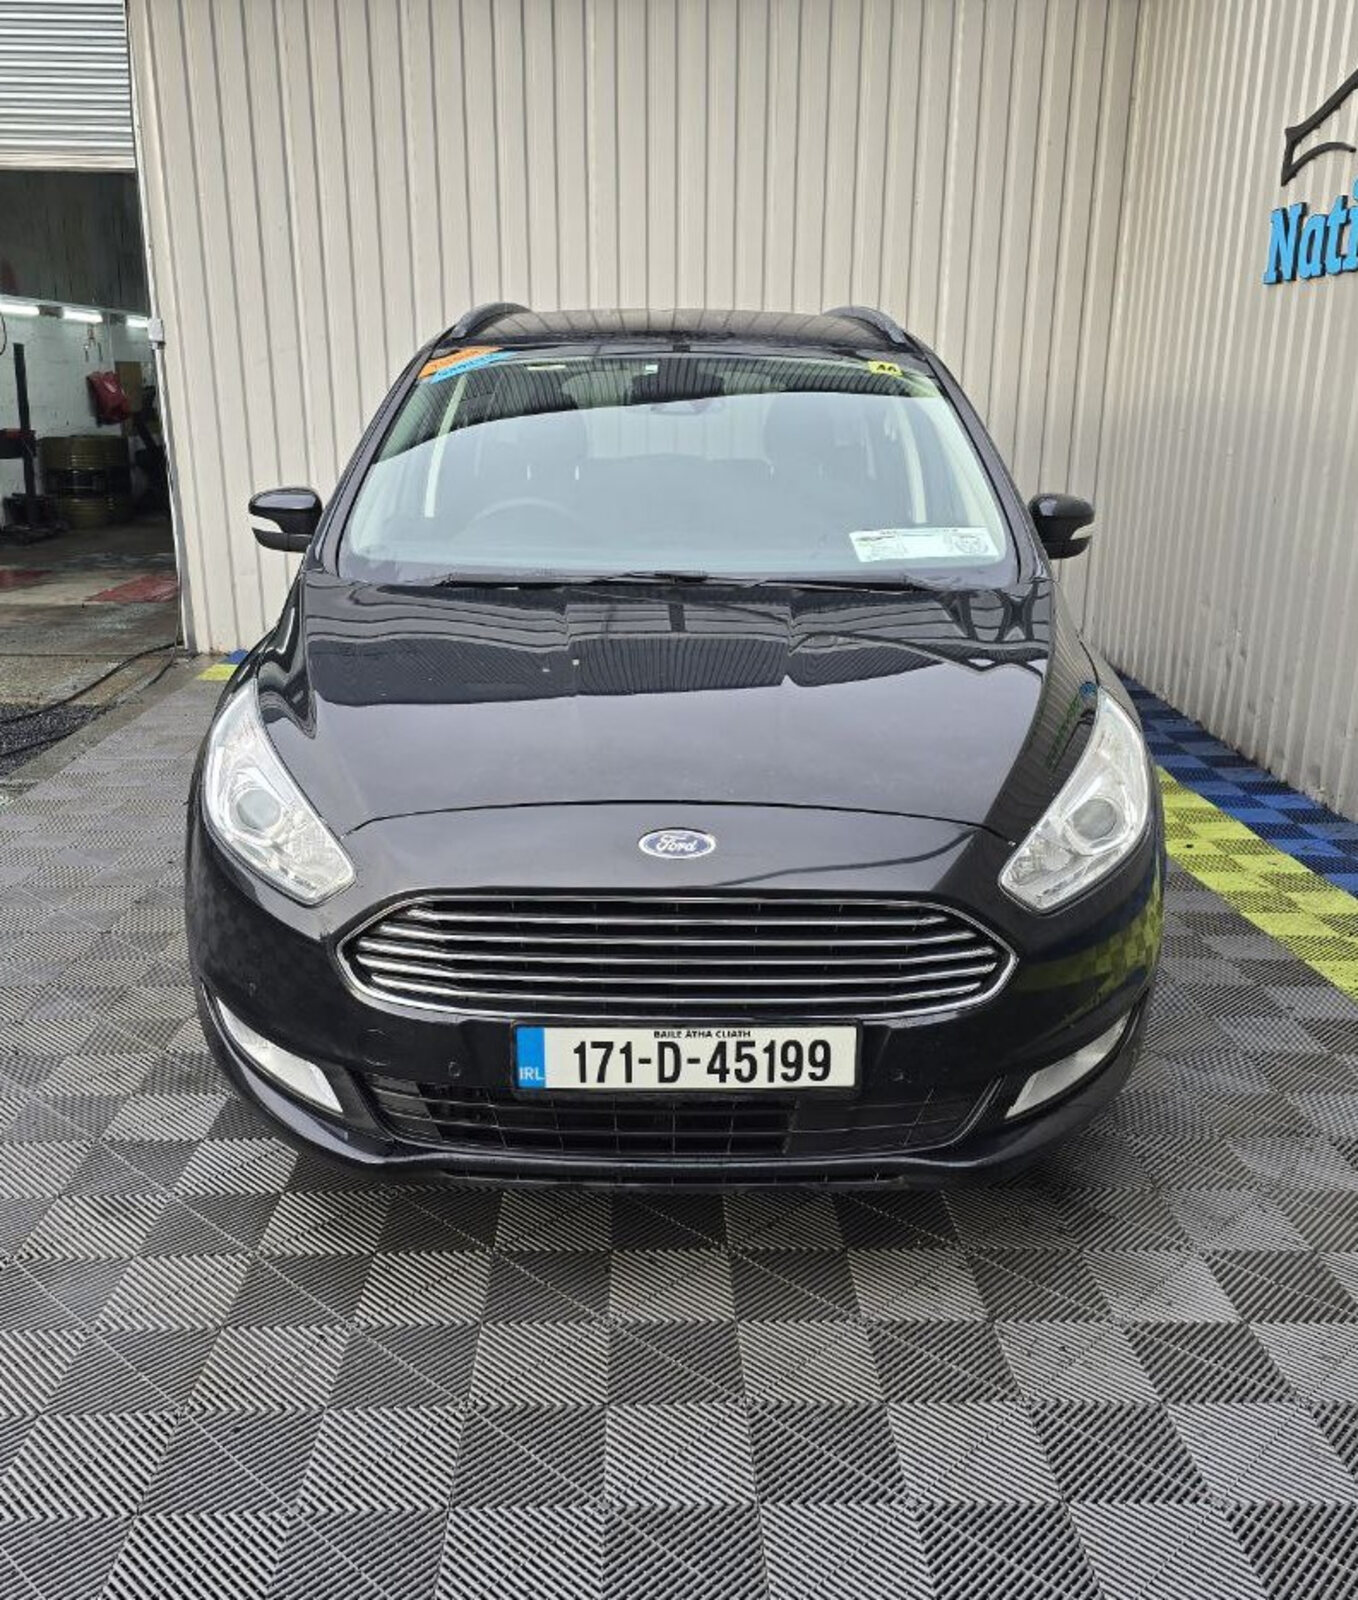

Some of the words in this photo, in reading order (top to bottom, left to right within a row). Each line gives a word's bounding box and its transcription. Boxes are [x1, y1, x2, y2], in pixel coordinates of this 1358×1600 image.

[656, 834, 698, 852] Ford
[653, 1030, 682, 1038] BAILE
[715, 1030, 751, 1038] CLIATH
[573, 1040, 831, 1083] 171-D-45199
[519, 1066, 545, 1081] IRL
